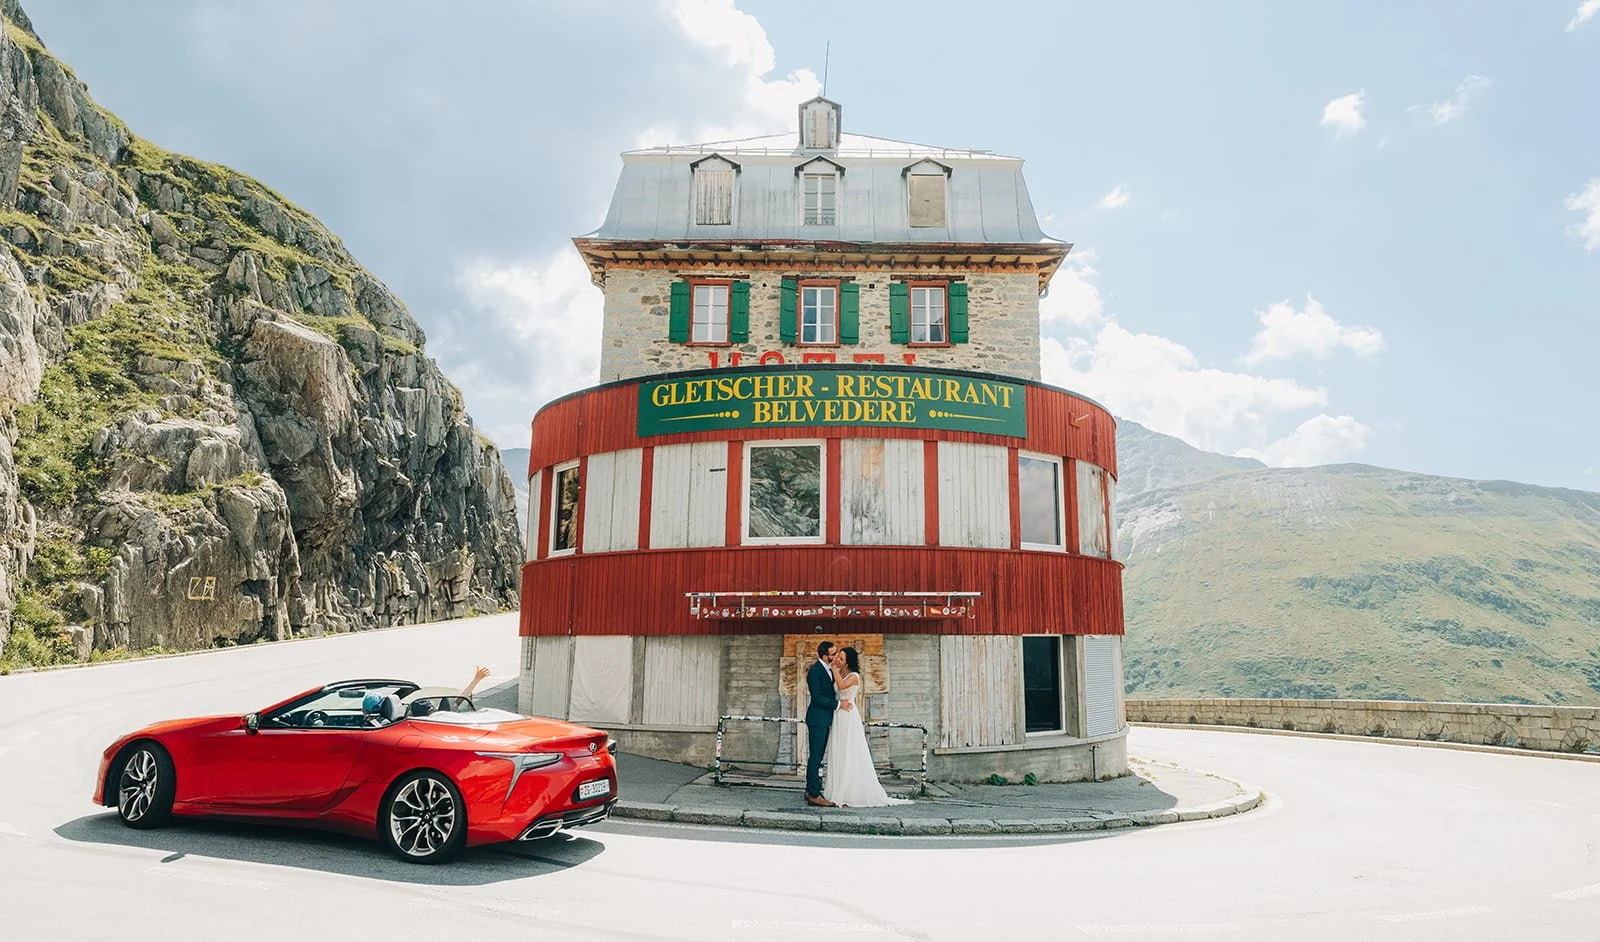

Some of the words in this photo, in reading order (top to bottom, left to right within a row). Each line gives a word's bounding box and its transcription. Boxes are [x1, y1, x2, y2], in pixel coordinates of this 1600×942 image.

[652, 375, 814, 407] GLETSCHER
[837, 375, 1014, 408] RESTAURANT
[753, 400, 917, 423] BELVEDERE
